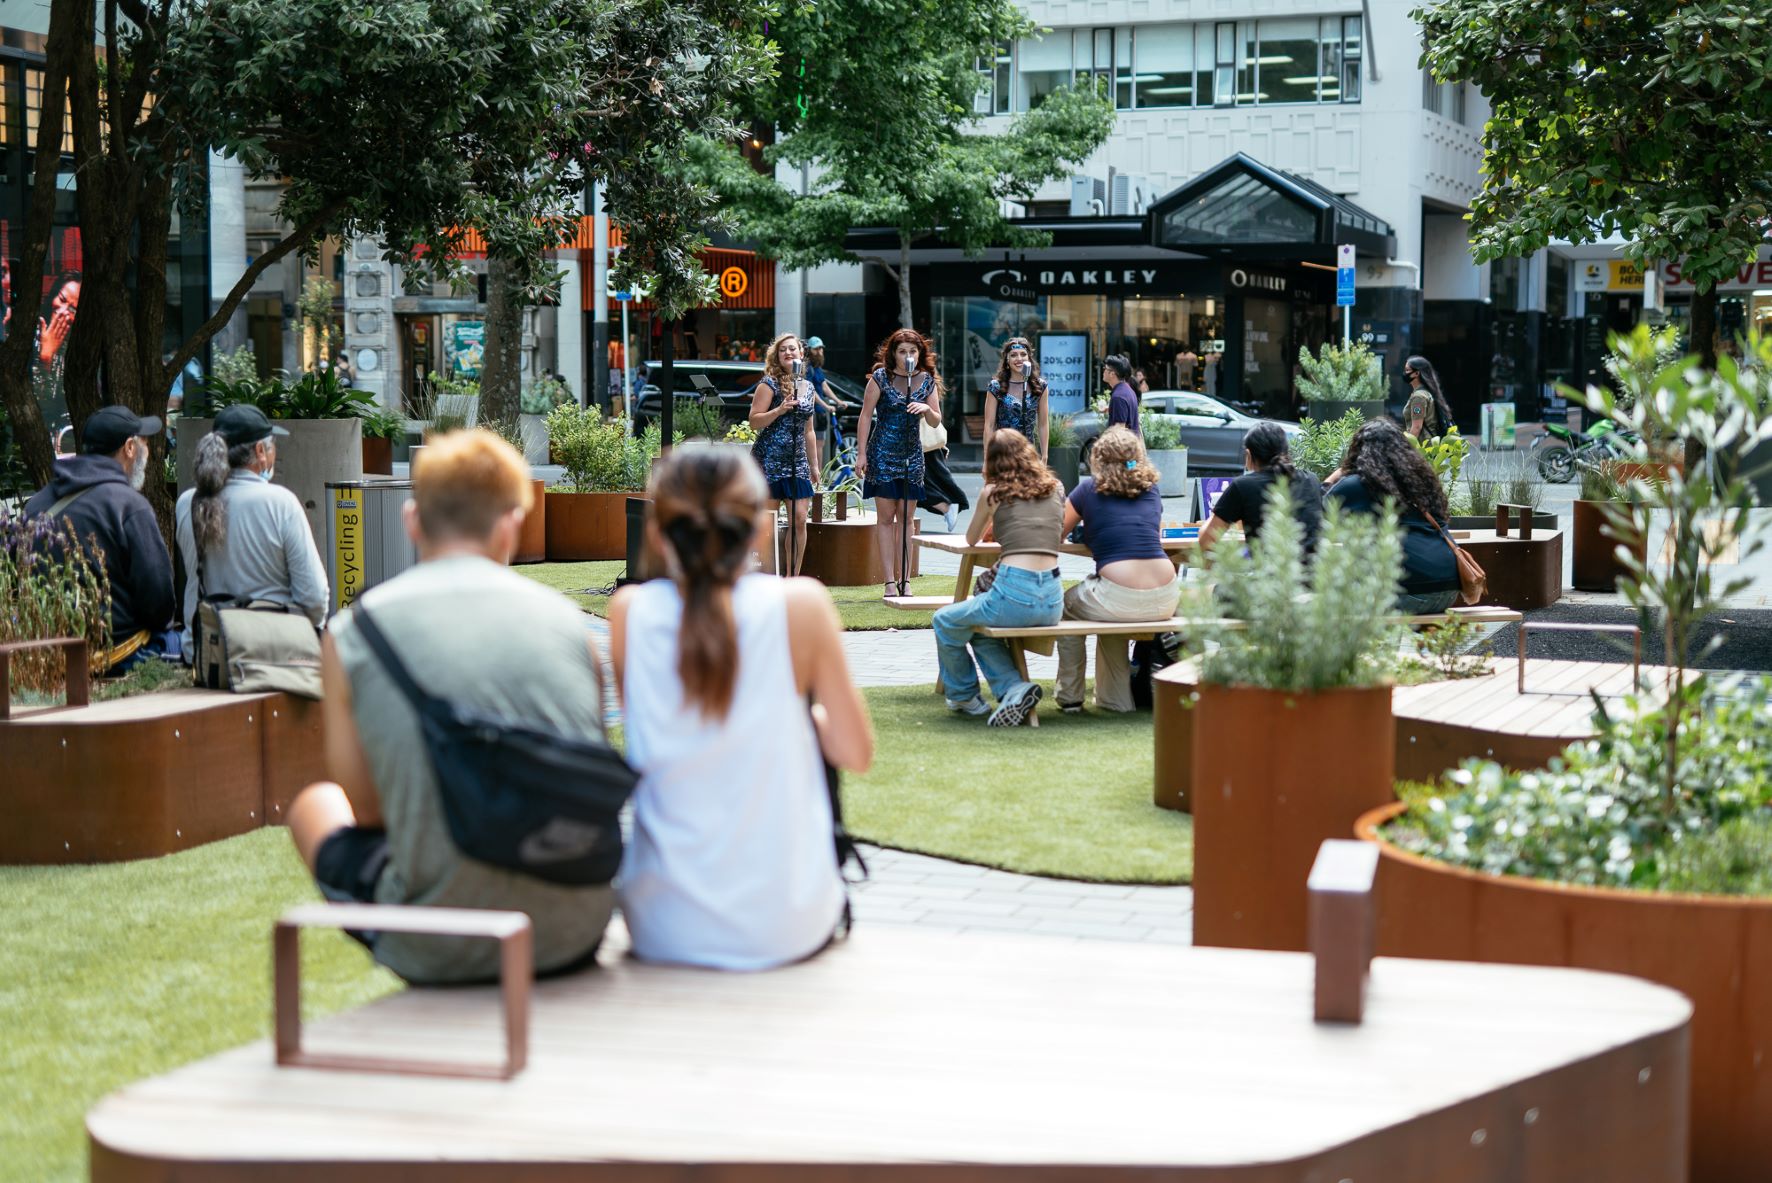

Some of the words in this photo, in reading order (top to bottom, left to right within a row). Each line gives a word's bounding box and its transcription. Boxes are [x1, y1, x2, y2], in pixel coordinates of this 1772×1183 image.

[1040, 270, 1157, 285] OAKLEY
[1665, 261, 1772, 286] SVE
[1043, 356, 1063, 365] 20%
[1065, 356, 1082, 365] OFF
[1065, 373, 1082, 382] OFF
[1048, 389, 1063, 398] 0%
[1065, 389, 1082, 398] OFF
